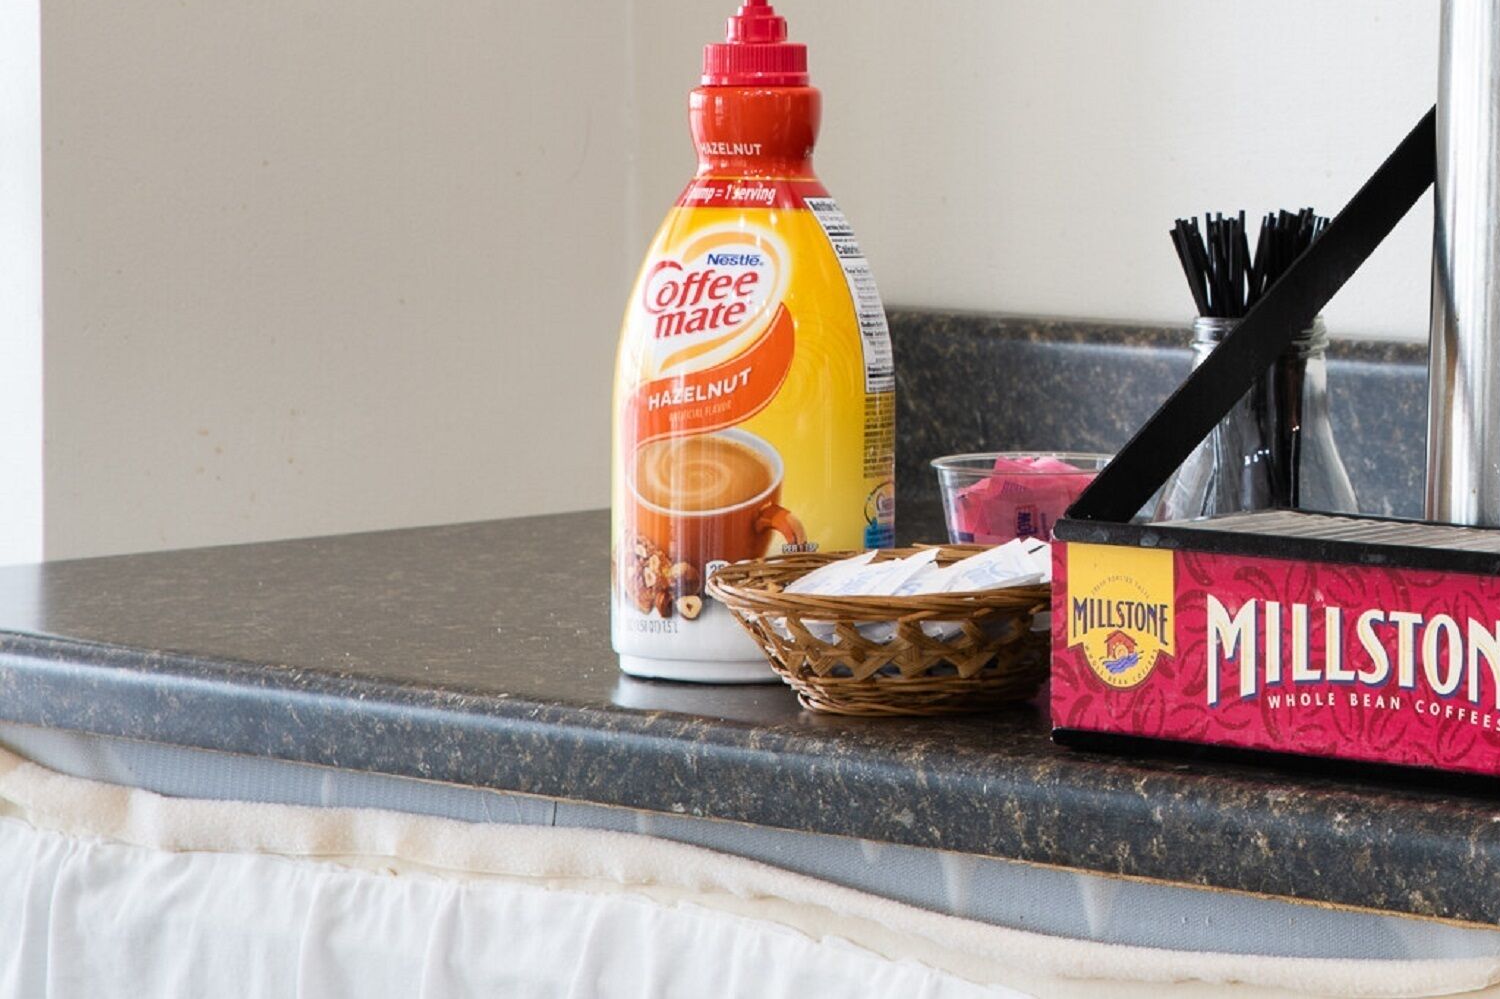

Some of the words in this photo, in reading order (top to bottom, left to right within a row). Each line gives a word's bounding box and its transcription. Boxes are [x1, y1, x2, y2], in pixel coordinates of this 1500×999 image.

[700, 142, 762, 155] HAZELNUT
[733, 182, 777, 205] serving
[643, 260, 759, 315] Coffee
[655, 302, 747, 339] mate
[648, 366, 752, 412] HAZELNUT
[1072, 595, 1169, 647] MILLSTONE
[1267, 692, 1336, 710] WHOLE
[1350, 692, 1401, 710] BEAN
